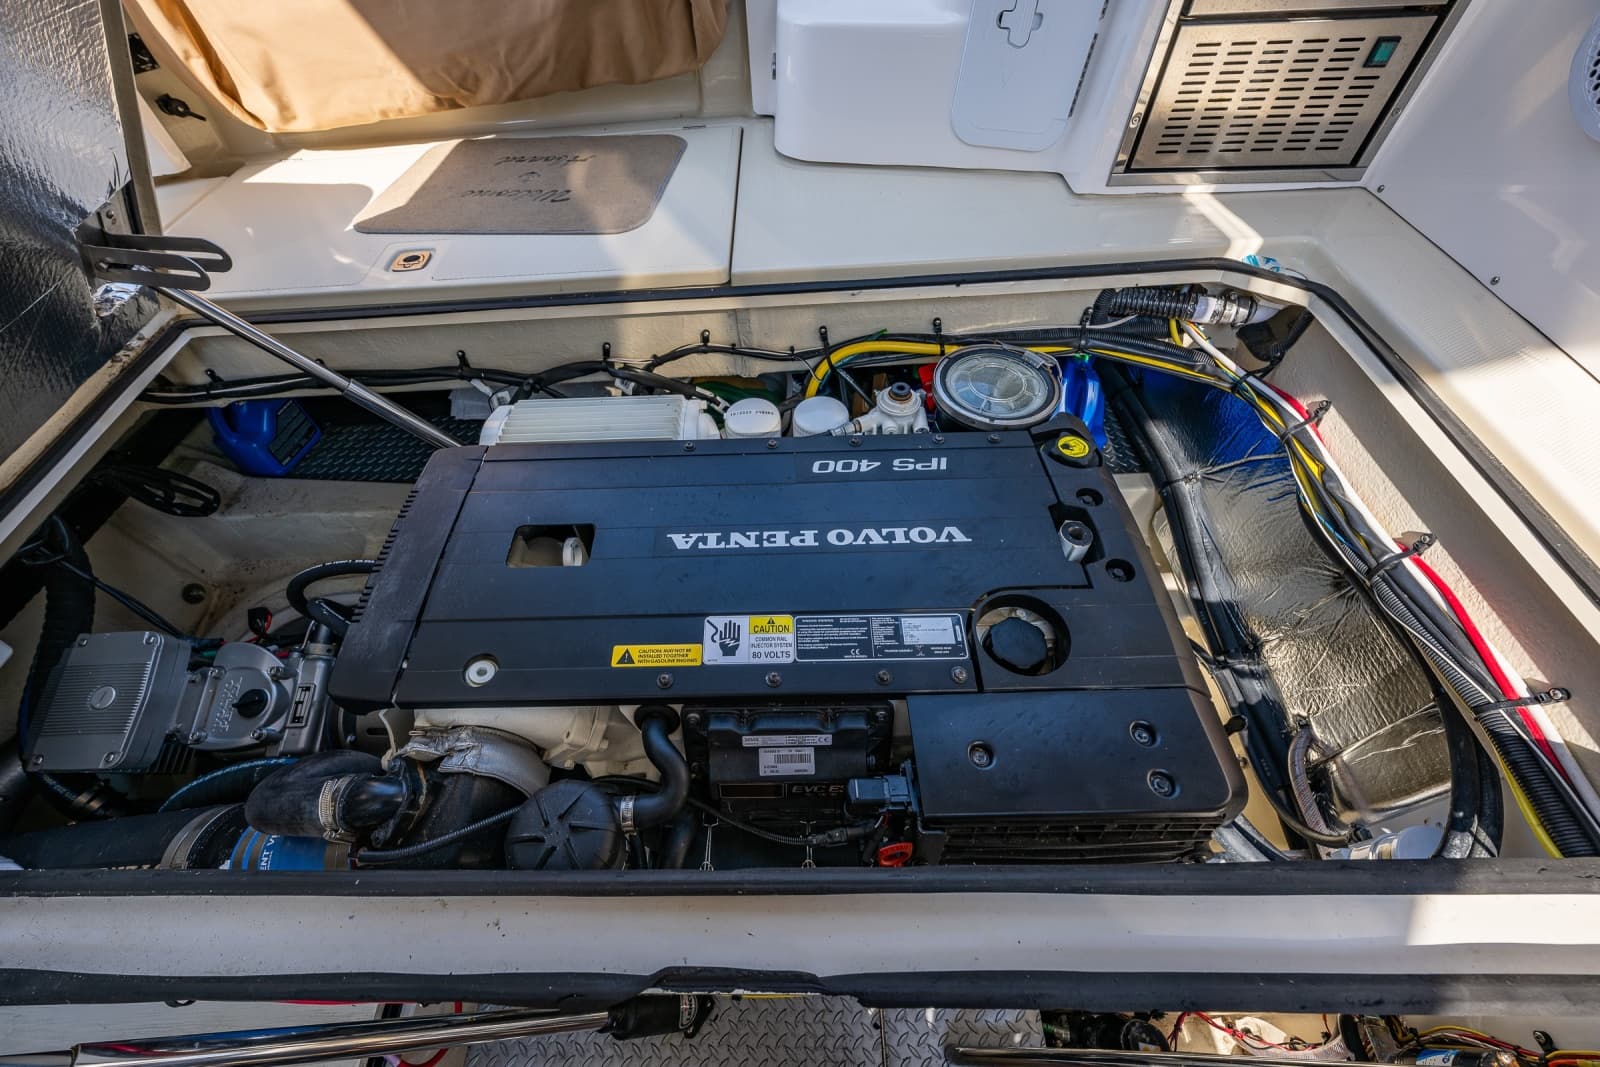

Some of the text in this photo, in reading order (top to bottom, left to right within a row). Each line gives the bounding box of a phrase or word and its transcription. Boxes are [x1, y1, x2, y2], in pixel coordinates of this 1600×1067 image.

[461, 189, 572, 203] Welcome
[812, 457, 947, 474] IPS 400
[666, 526, 972, 550] VOLVO PENTA
[753, 624, 790, 633] CAUTION
[752, 650, 791, 659] 80 VOLTS
